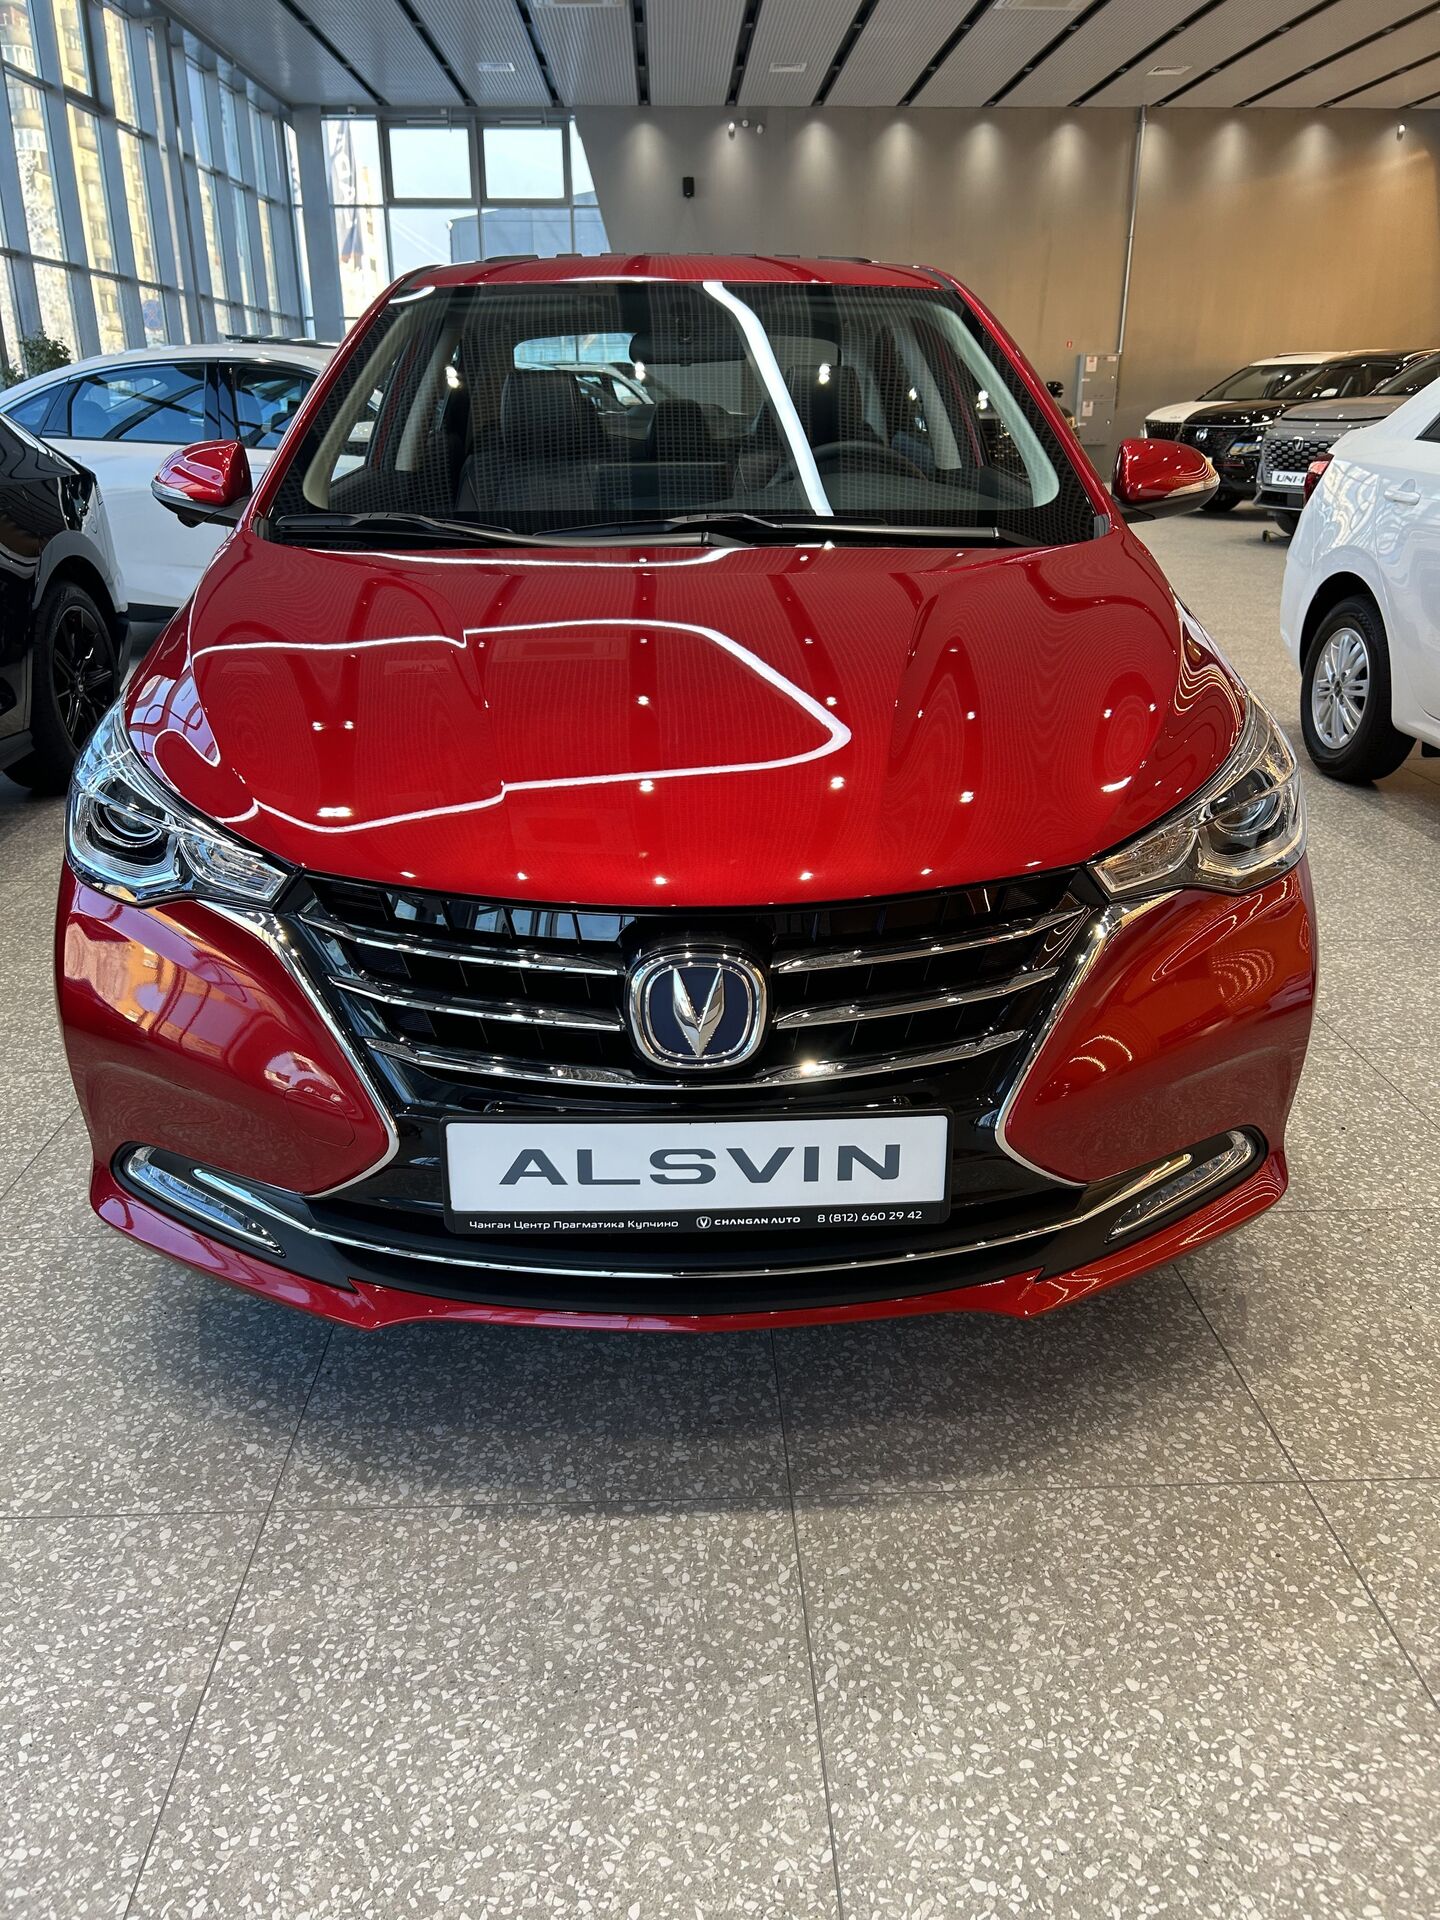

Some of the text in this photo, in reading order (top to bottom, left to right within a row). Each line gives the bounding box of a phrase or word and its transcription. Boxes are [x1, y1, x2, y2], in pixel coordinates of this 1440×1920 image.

[1276, 474, 1306, 484] UNI-
[499, 1143, 901, 1186] ALSVIN
[714, 1215, 801, 1226] CHANGAN AUTO
[817, 1210, 922, 1224] 8 (812) 660 29 42
[469, 1219, 679, 1230] Чанган Центр Прагматика Купчино
